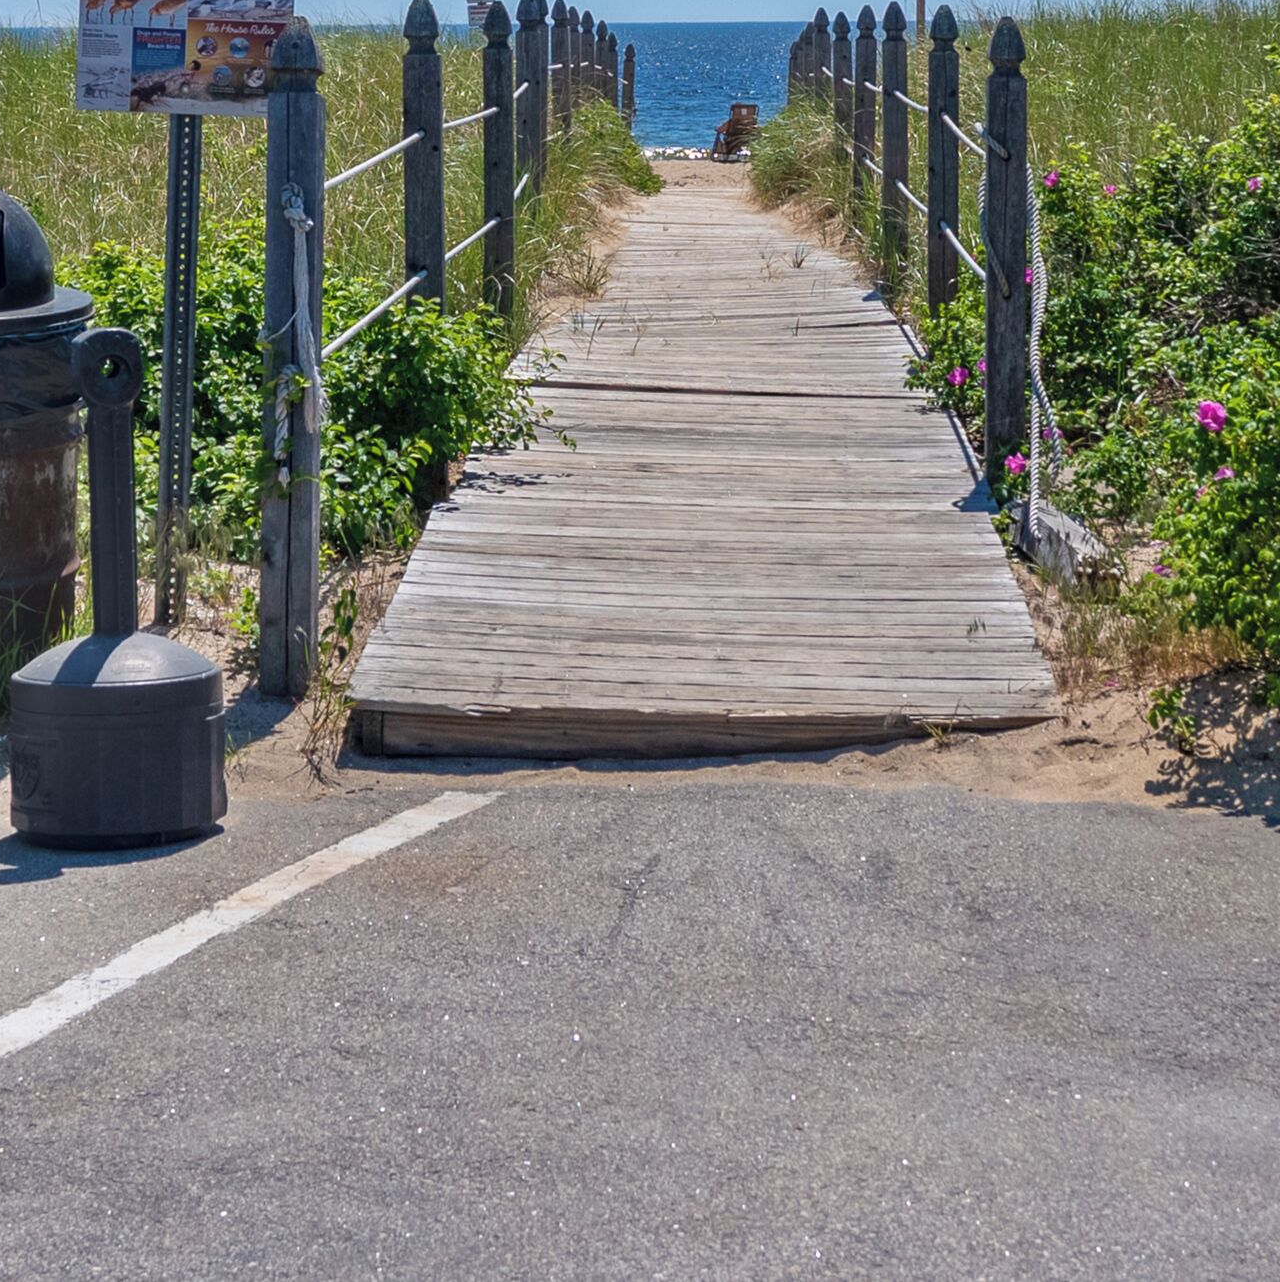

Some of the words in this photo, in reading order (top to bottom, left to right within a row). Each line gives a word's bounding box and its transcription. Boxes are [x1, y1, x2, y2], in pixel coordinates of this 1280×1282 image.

[204, 21, 220, 33] The
[221, 23, 249, 34] House
[249, 24, 277, 36] Rules
